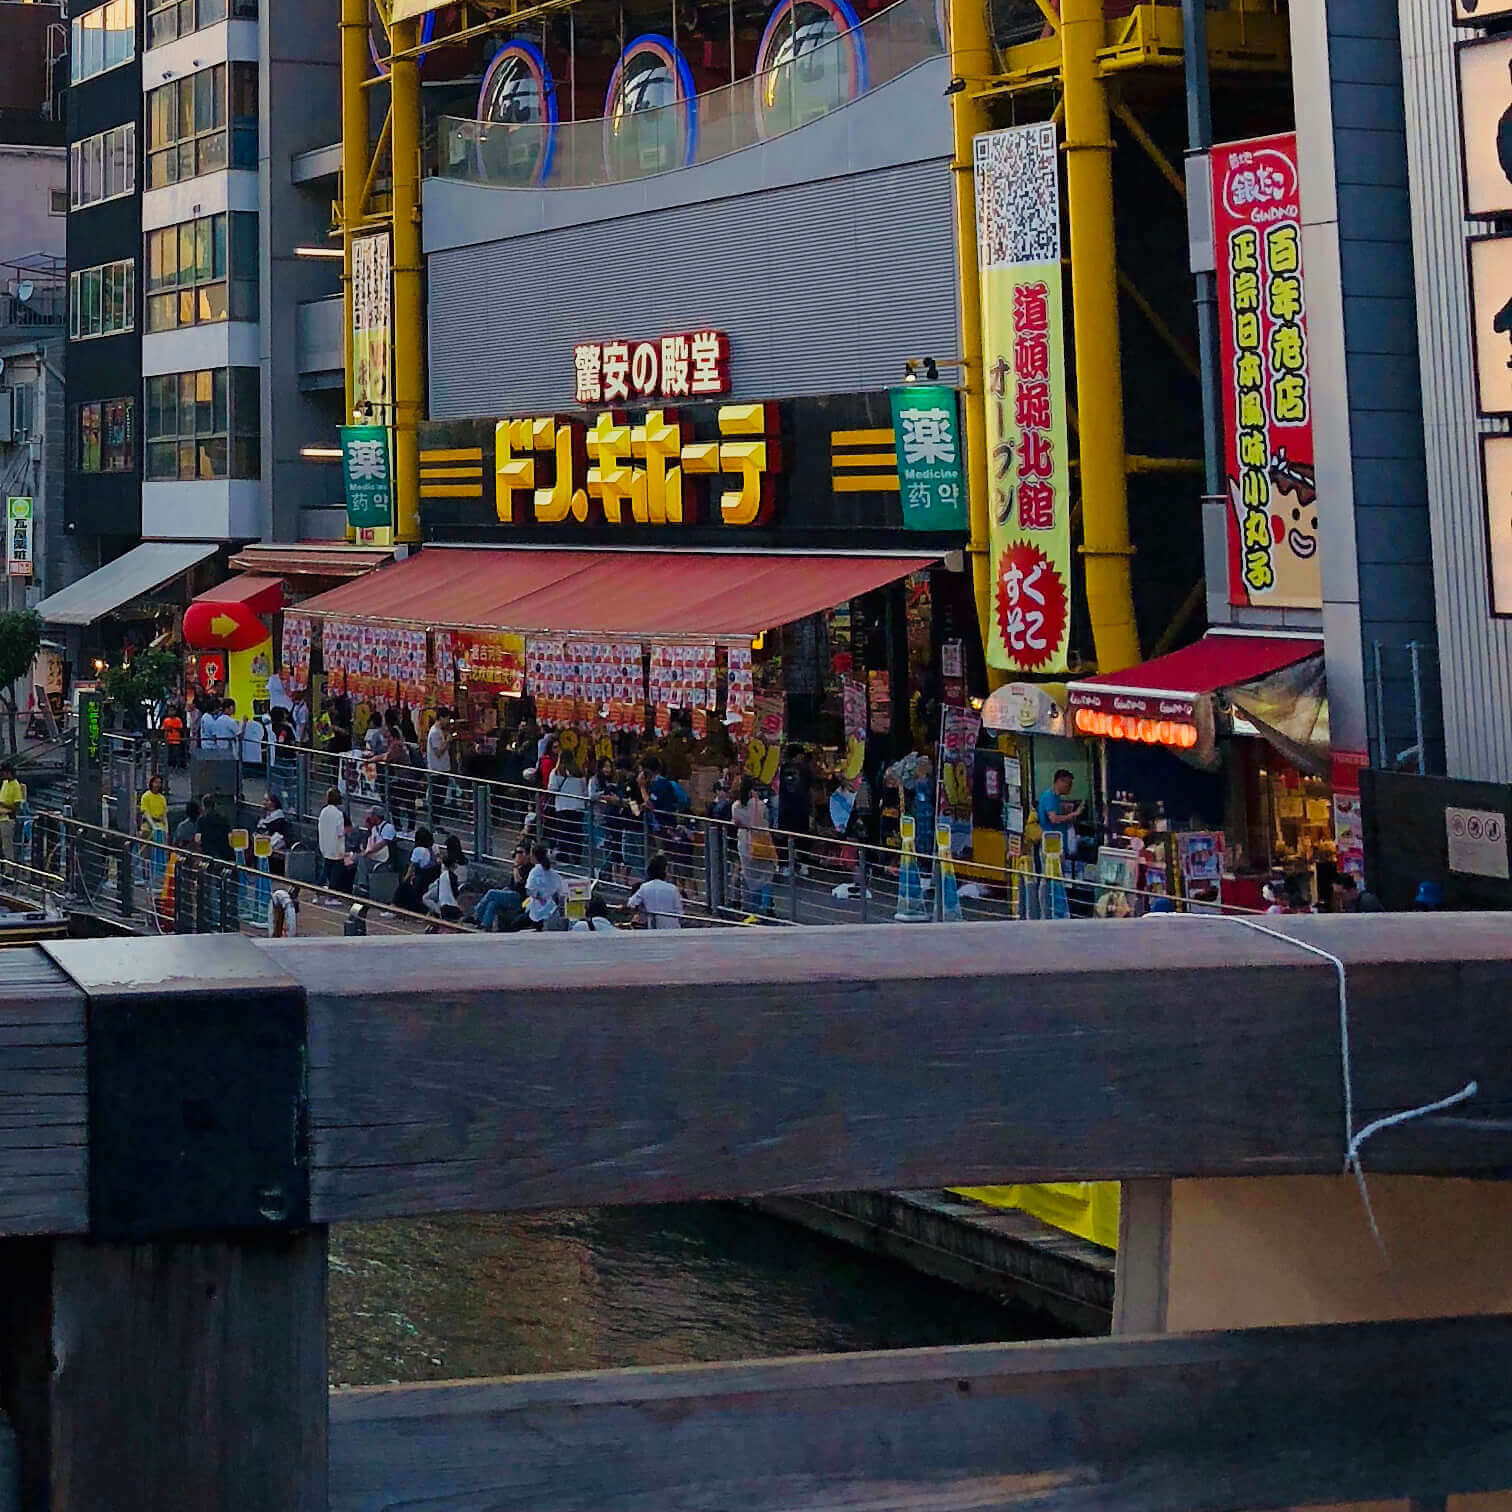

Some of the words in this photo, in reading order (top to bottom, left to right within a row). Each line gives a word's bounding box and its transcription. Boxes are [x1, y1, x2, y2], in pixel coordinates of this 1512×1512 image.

[1266, 224, 1309, 426] 百年老店
[575, 332, 722, 403] 驚安の殿堂
[900, 407, 956, 465] 薬
[1013, 280, 1055, 530] 道頓堀北館
[1229, 228, 1277, 591] 正宗日本風味小丸子
[348, 439, 386, 480] 薬
[905, 469, 959, 480] Medicine
